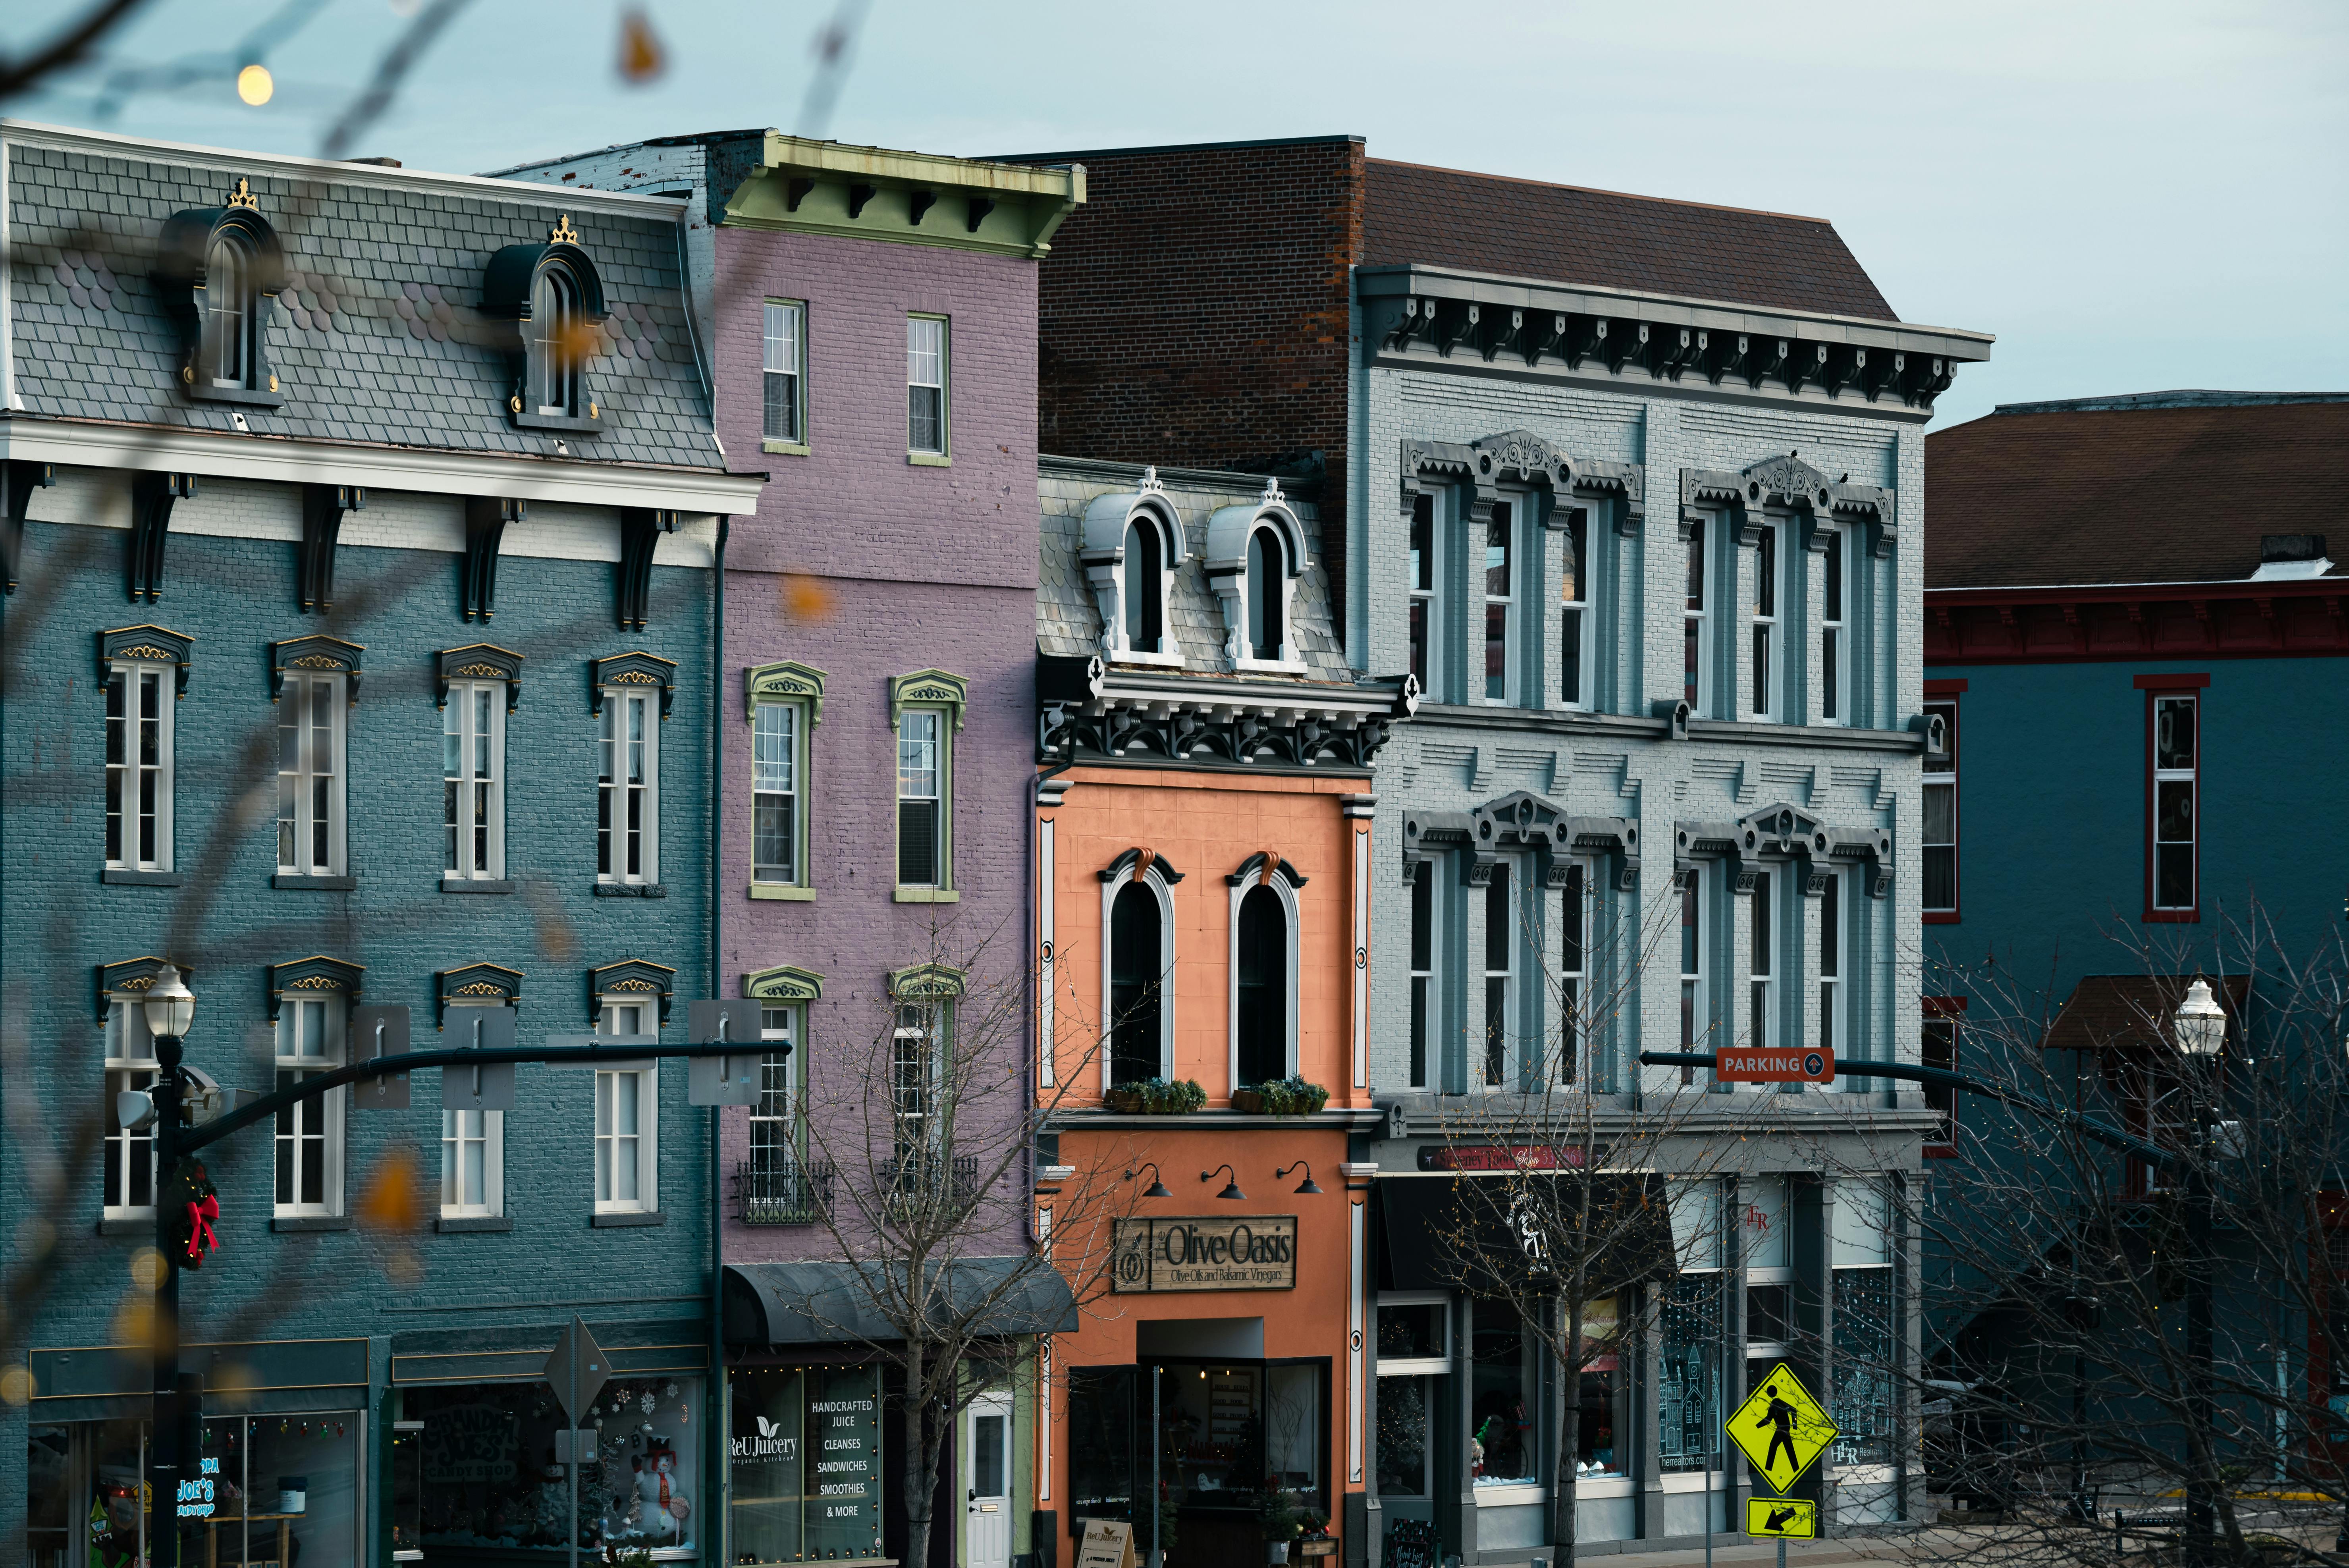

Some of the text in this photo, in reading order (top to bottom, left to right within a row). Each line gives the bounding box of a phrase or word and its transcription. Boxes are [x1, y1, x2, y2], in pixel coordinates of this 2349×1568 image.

[1725, 1058, 1799, 1071] PARKING
[1166, 1224, 1290, 1265] Olive Oasis
[1171, 1268, 1282, 1283] Olive Oils and Balsamic Vinegars
[812, 1400, 873, 1413] HANDCRAFTED
[832, 1416, 854, 1427] JUICE
[422, 1410, 515, 1450] GRANDPA
[824, 1438, 861, 1450] CLEANSES
[1831, 1441, 1859, 1464] HER
[428, 1465, 512, 1477] CANDY SHOP
[818, 1460, 867, 1473] SANDWICHES
[177, 1477, 214, 1502] JOE'S
[820, 1483, 864, 1495] SMOOTHIES
[197, 1503, 215, 1517] SHOP
[827, 1506, 858, 1517] & MORE
[1396, 1545, 1423, 1562] think big
